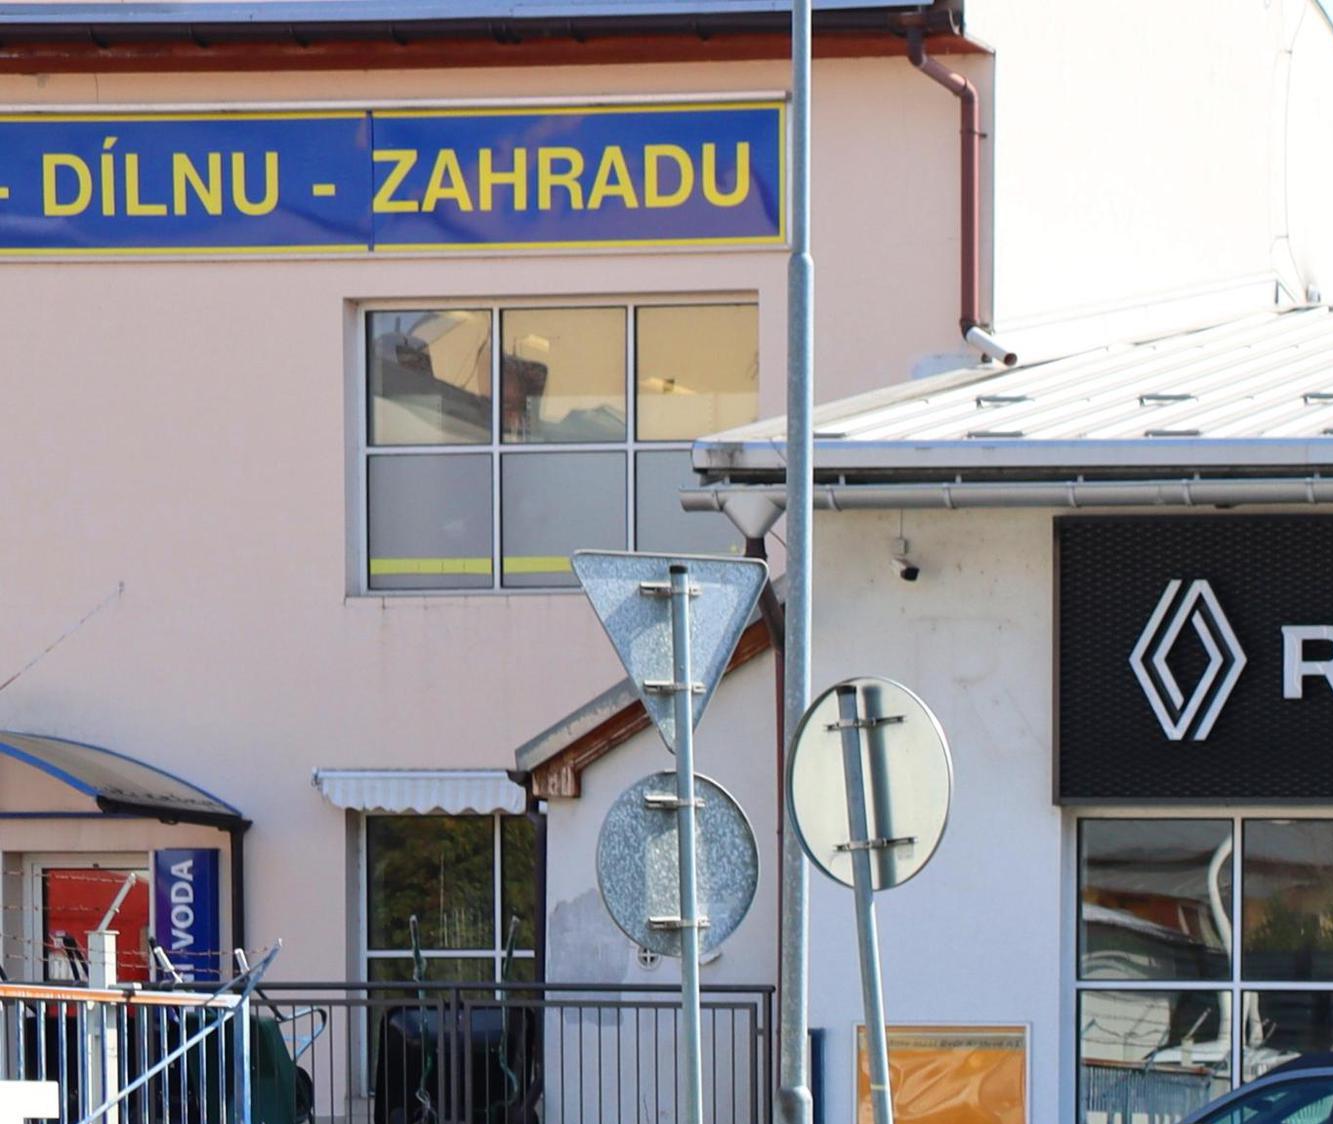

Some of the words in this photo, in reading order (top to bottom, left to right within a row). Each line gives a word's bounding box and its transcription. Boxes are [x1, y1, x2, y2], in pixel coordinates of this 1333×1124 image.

[42, 136, 279, 217] DÍLNU
[372, 141, 750, 214] ZAHRADU
[170, 859, 195, 949] VODA
